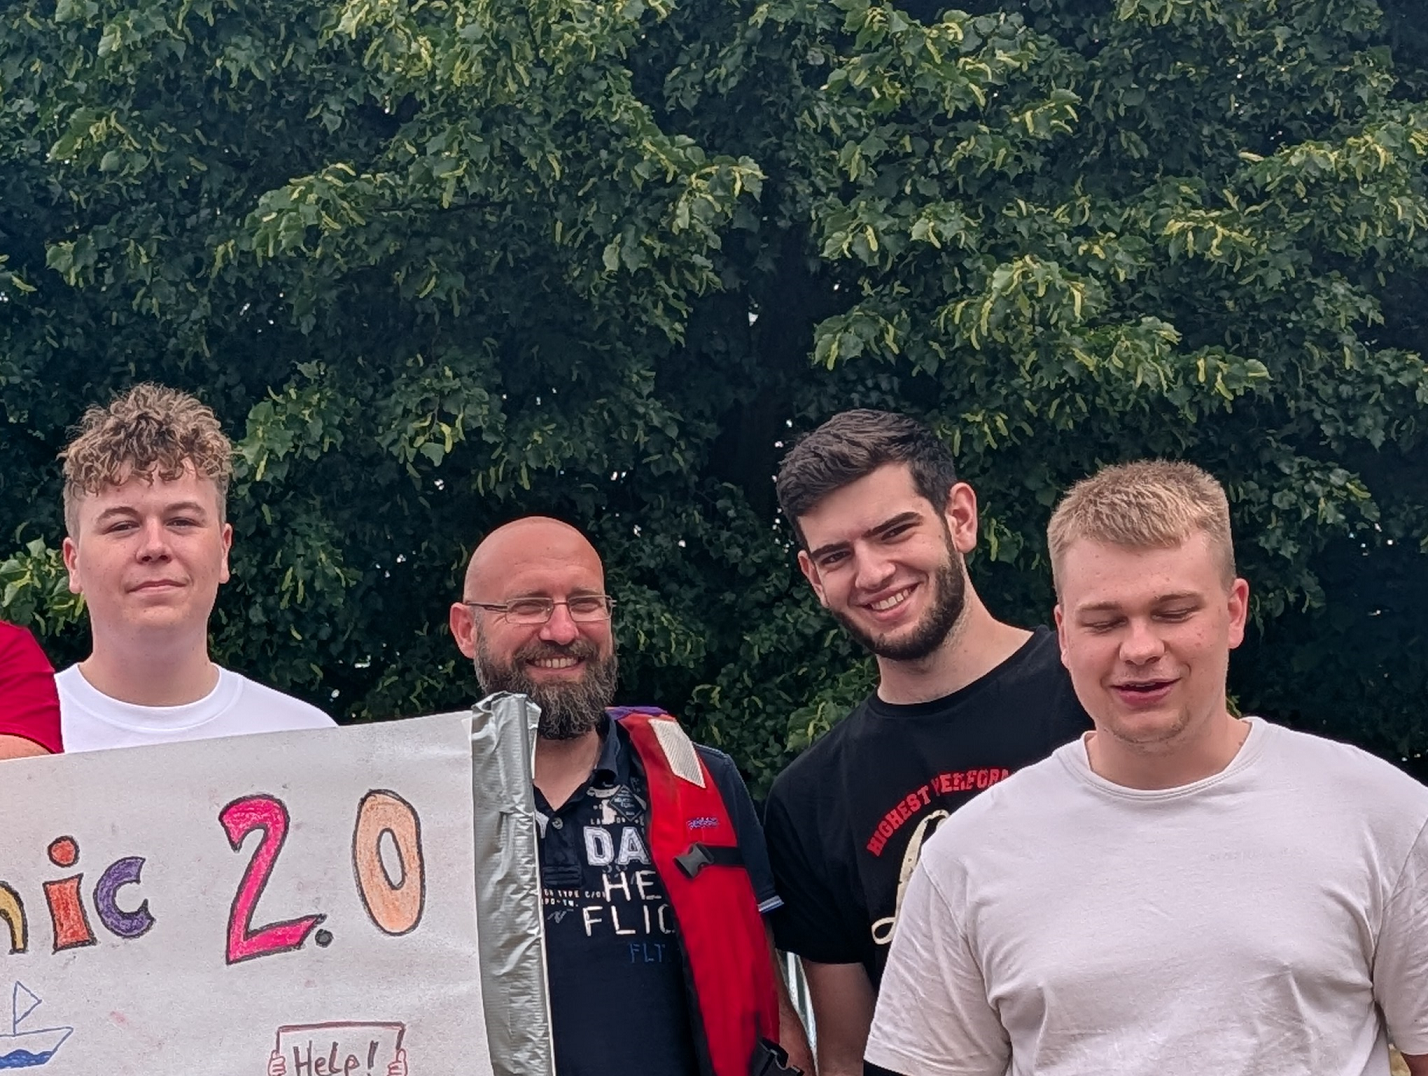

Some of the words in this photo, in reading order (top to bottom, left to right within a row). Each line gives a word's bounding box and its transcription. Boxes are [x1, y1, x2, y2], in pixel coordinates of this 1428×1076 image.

[866, 785, 931, 857] HIGHEST
[218, 789, 426, 965] 2.0
[602, 870, 662, 901] HE
